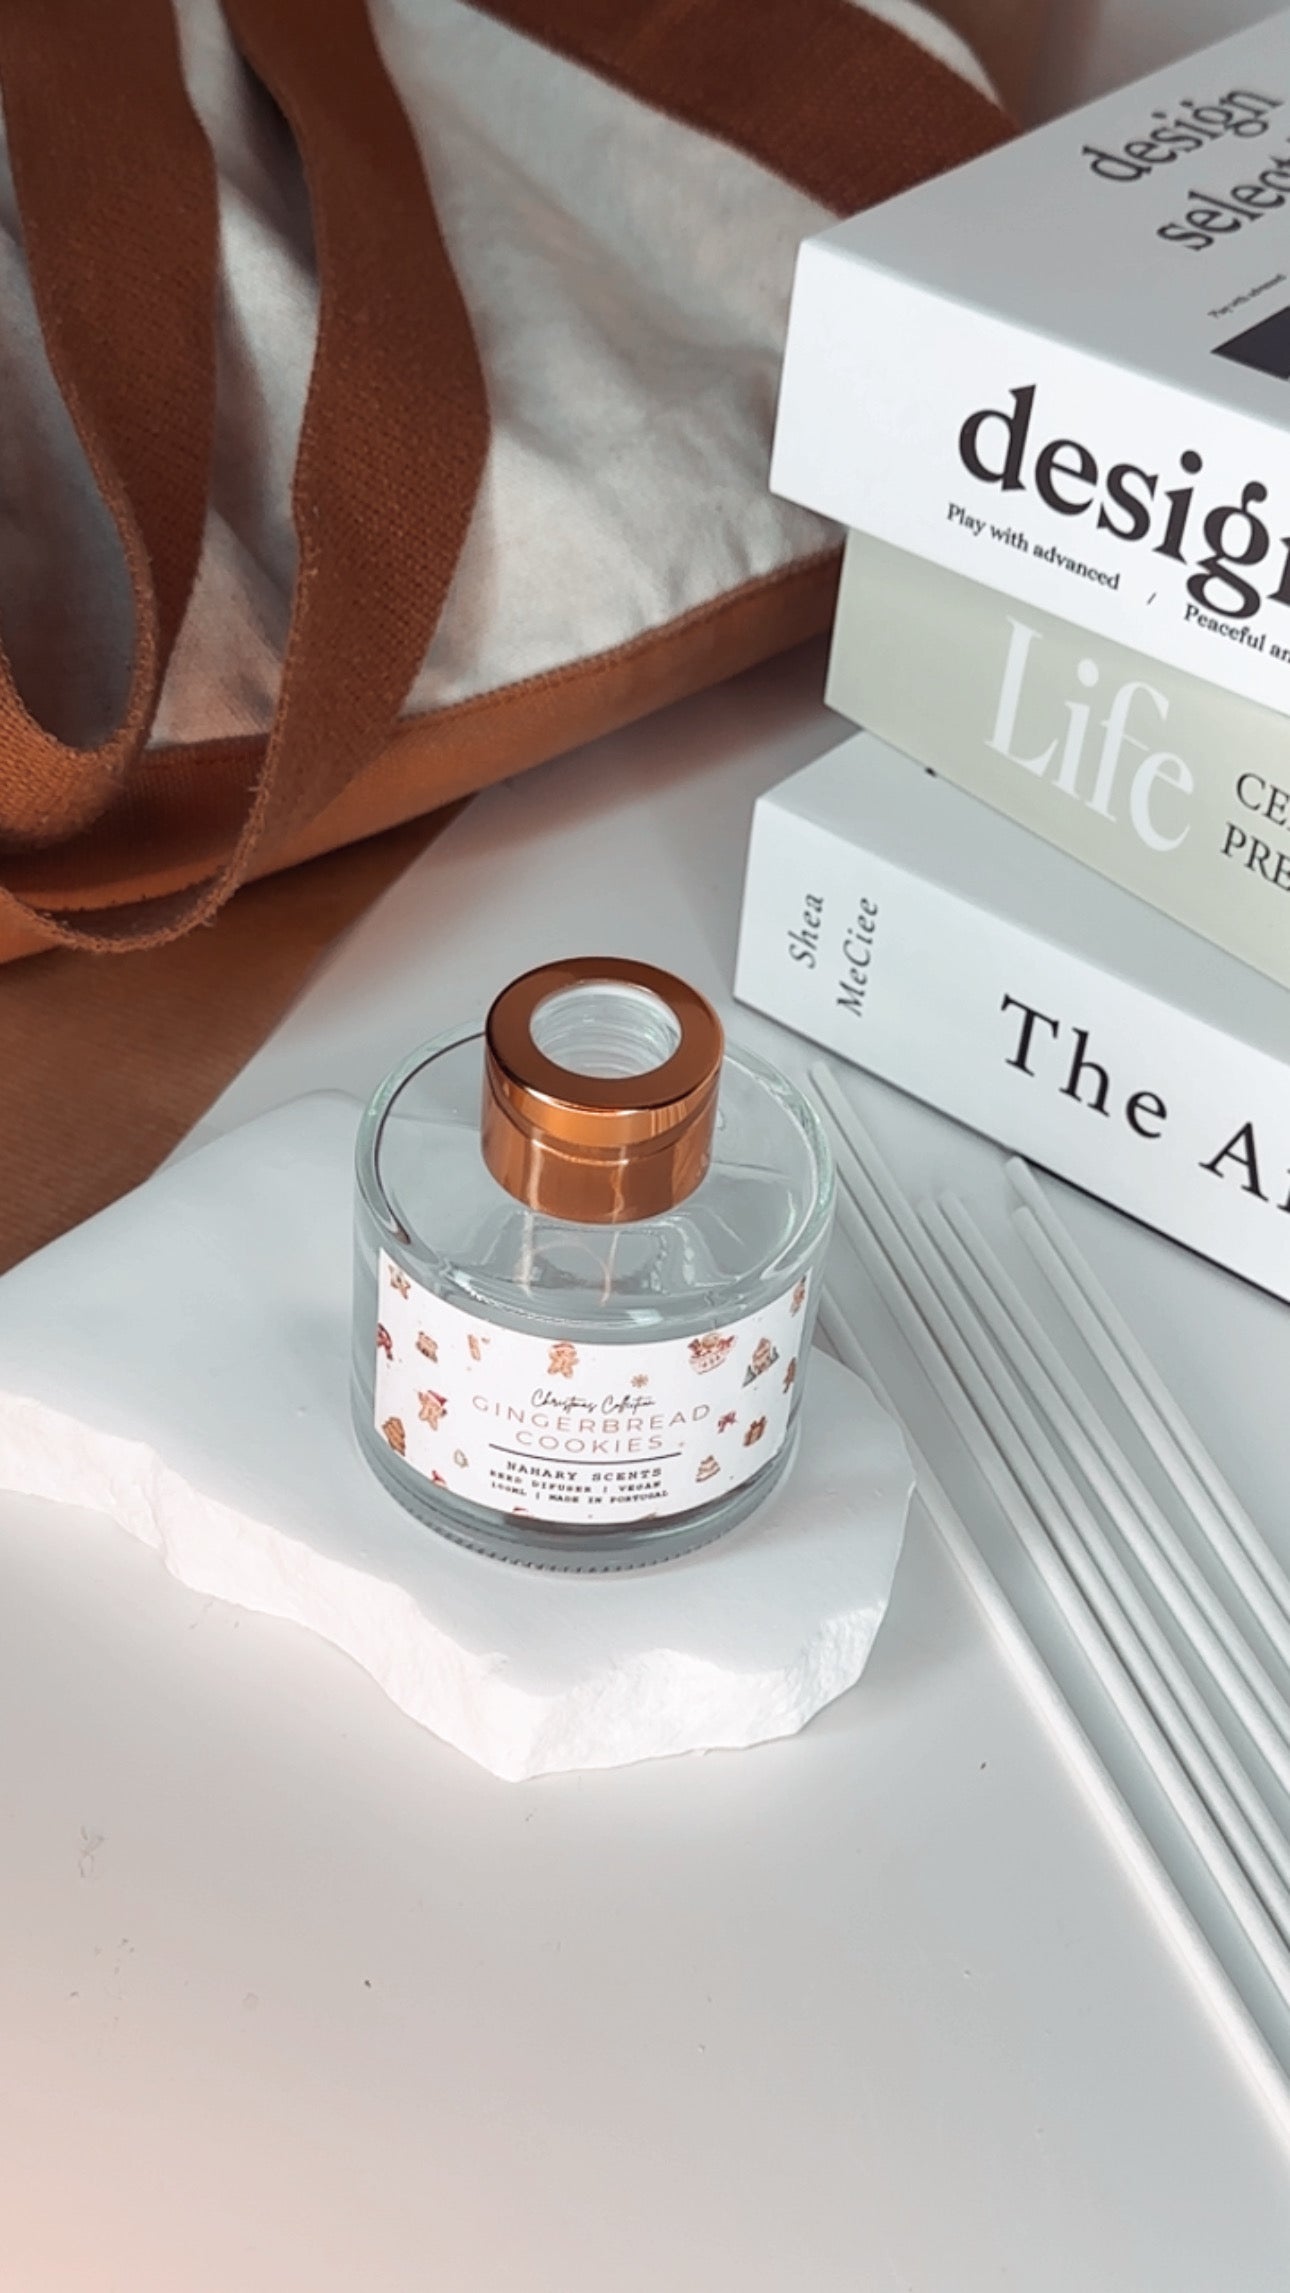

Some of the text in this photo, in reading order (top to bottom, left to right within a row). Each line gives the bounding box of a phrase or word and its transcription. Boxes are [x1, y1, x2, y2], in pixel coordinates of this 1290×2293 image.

[1081, 89, 1284, 183] design
[958, 383, 1290, 620] desig
[947, 502, 986, 537] Play
[990, 522, 1030, 553] with
[1032, 543, 1121, 592] advanced
[1184, 602, 1267, 653] Peaceful
[983, 615, 1194, 852] Life
[1236, 772, 1290, 832] CE
[787, 893, 824, 970] Shea
[1000, 993, 1290, 1214] The A
[472, 1394, 711, 1434] GINGERBREAD
[531, 1388, 657, 1416] Christmas Collection
[515, 1430, 663, 1454] COOKIES
[592, 1467, 663, 1482] SCENTS
[609, 1489, 669, 1504] PORTUGAL
[618, 1480, 662, 1492] VEGAN
